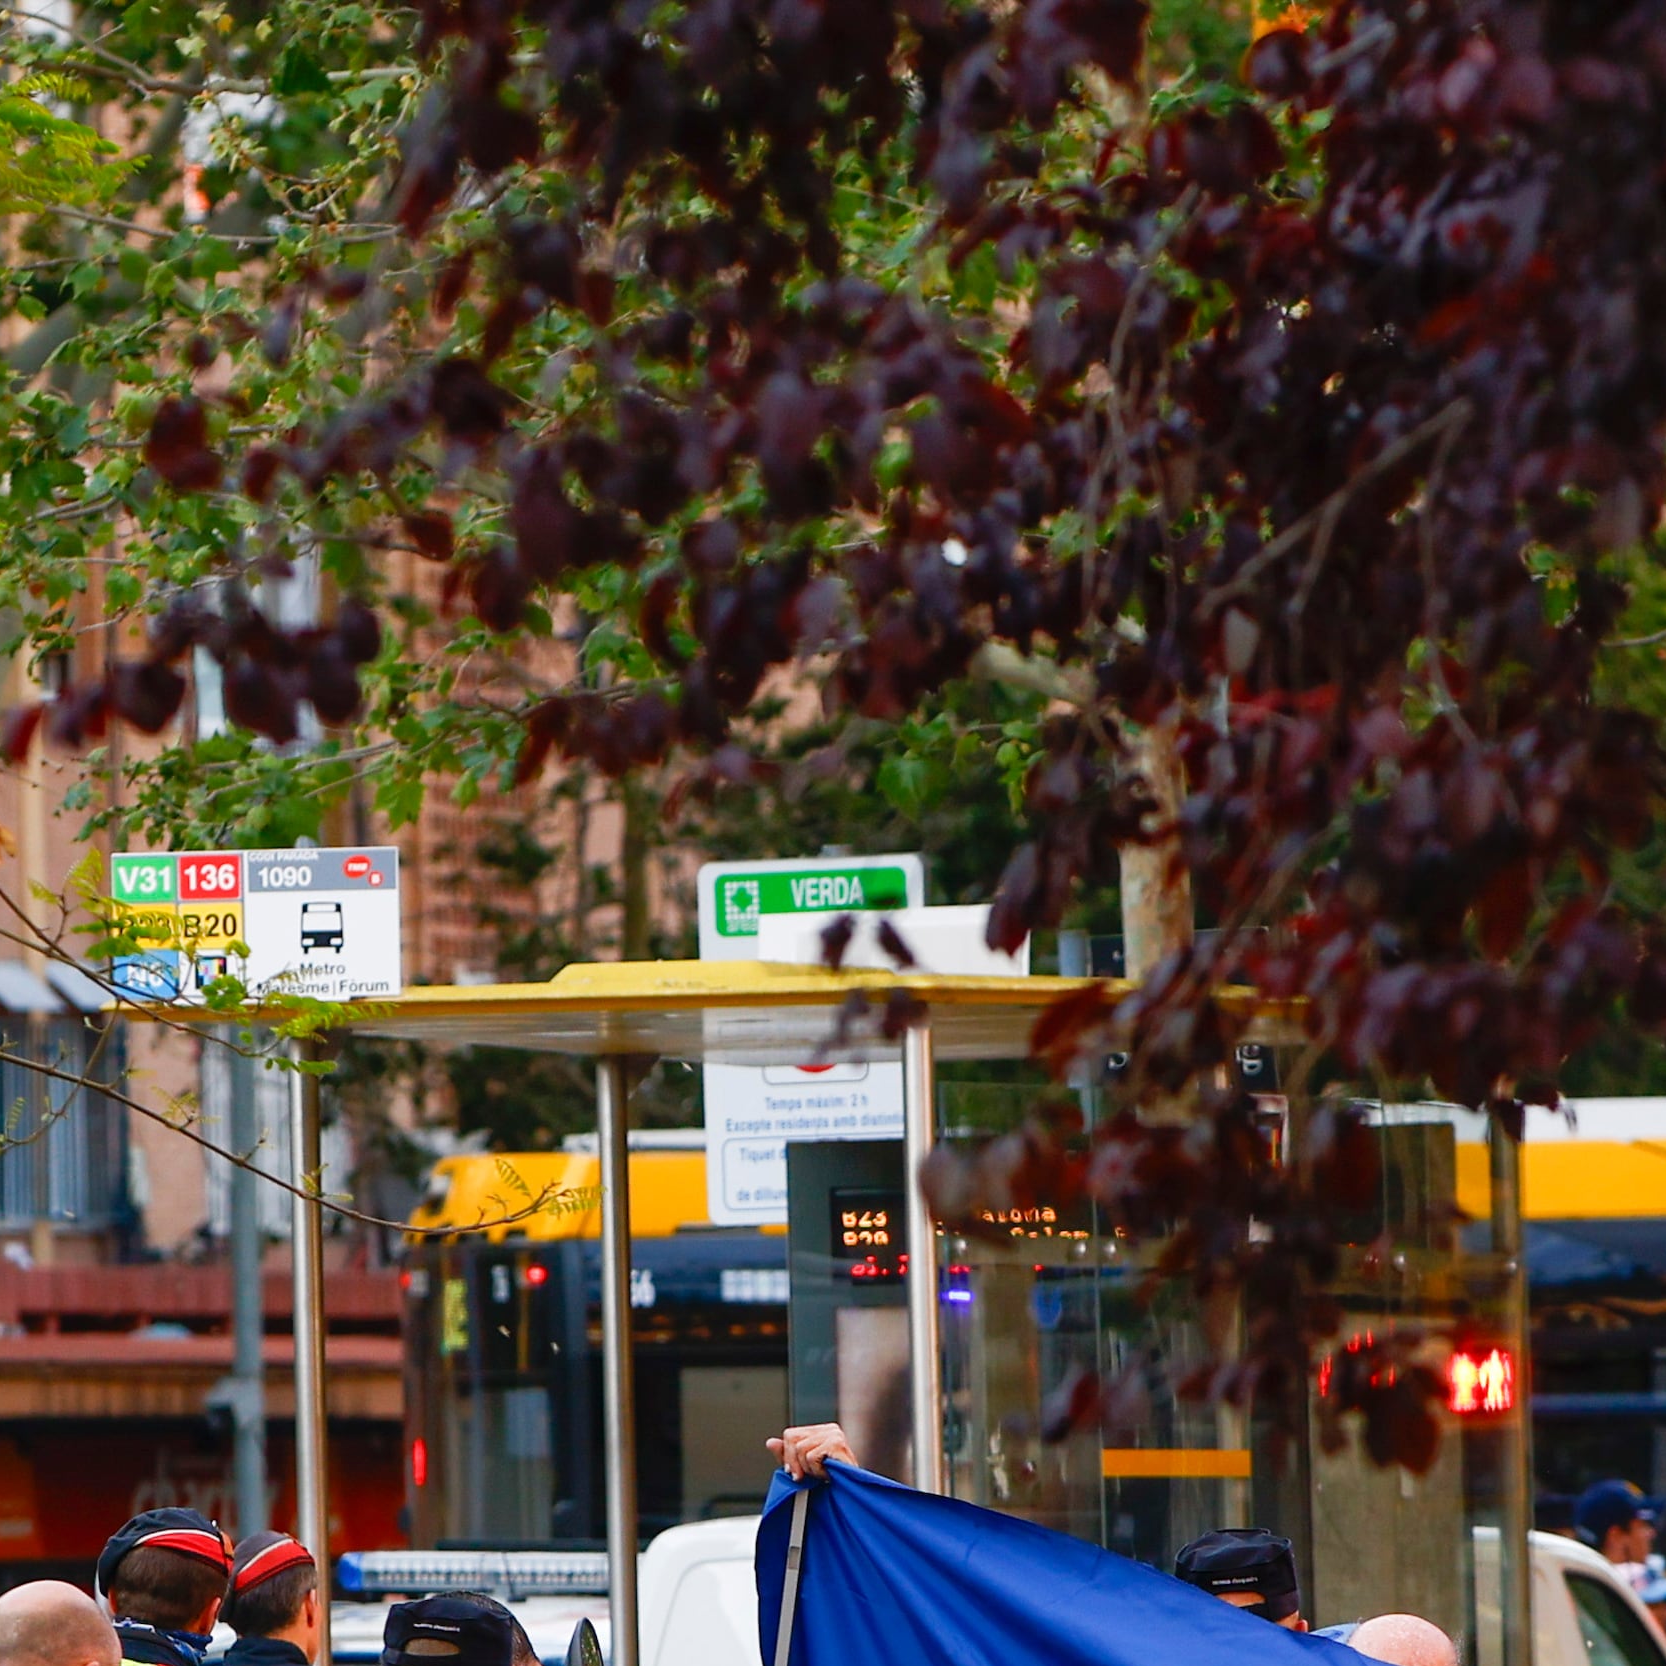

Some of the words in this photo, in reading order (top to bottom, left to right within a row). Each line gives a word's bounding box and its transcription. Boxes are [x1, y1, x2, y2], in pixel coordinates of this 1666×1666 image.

[117, 865, 171, 893] V31
[184, 864, 235, 891] 136
[258, 866, 312, 888] 1090
[791, 876, 864, 908] VERDA
[184, 913, 237, 938] B20
[300, 963, 345, 976] Metro
